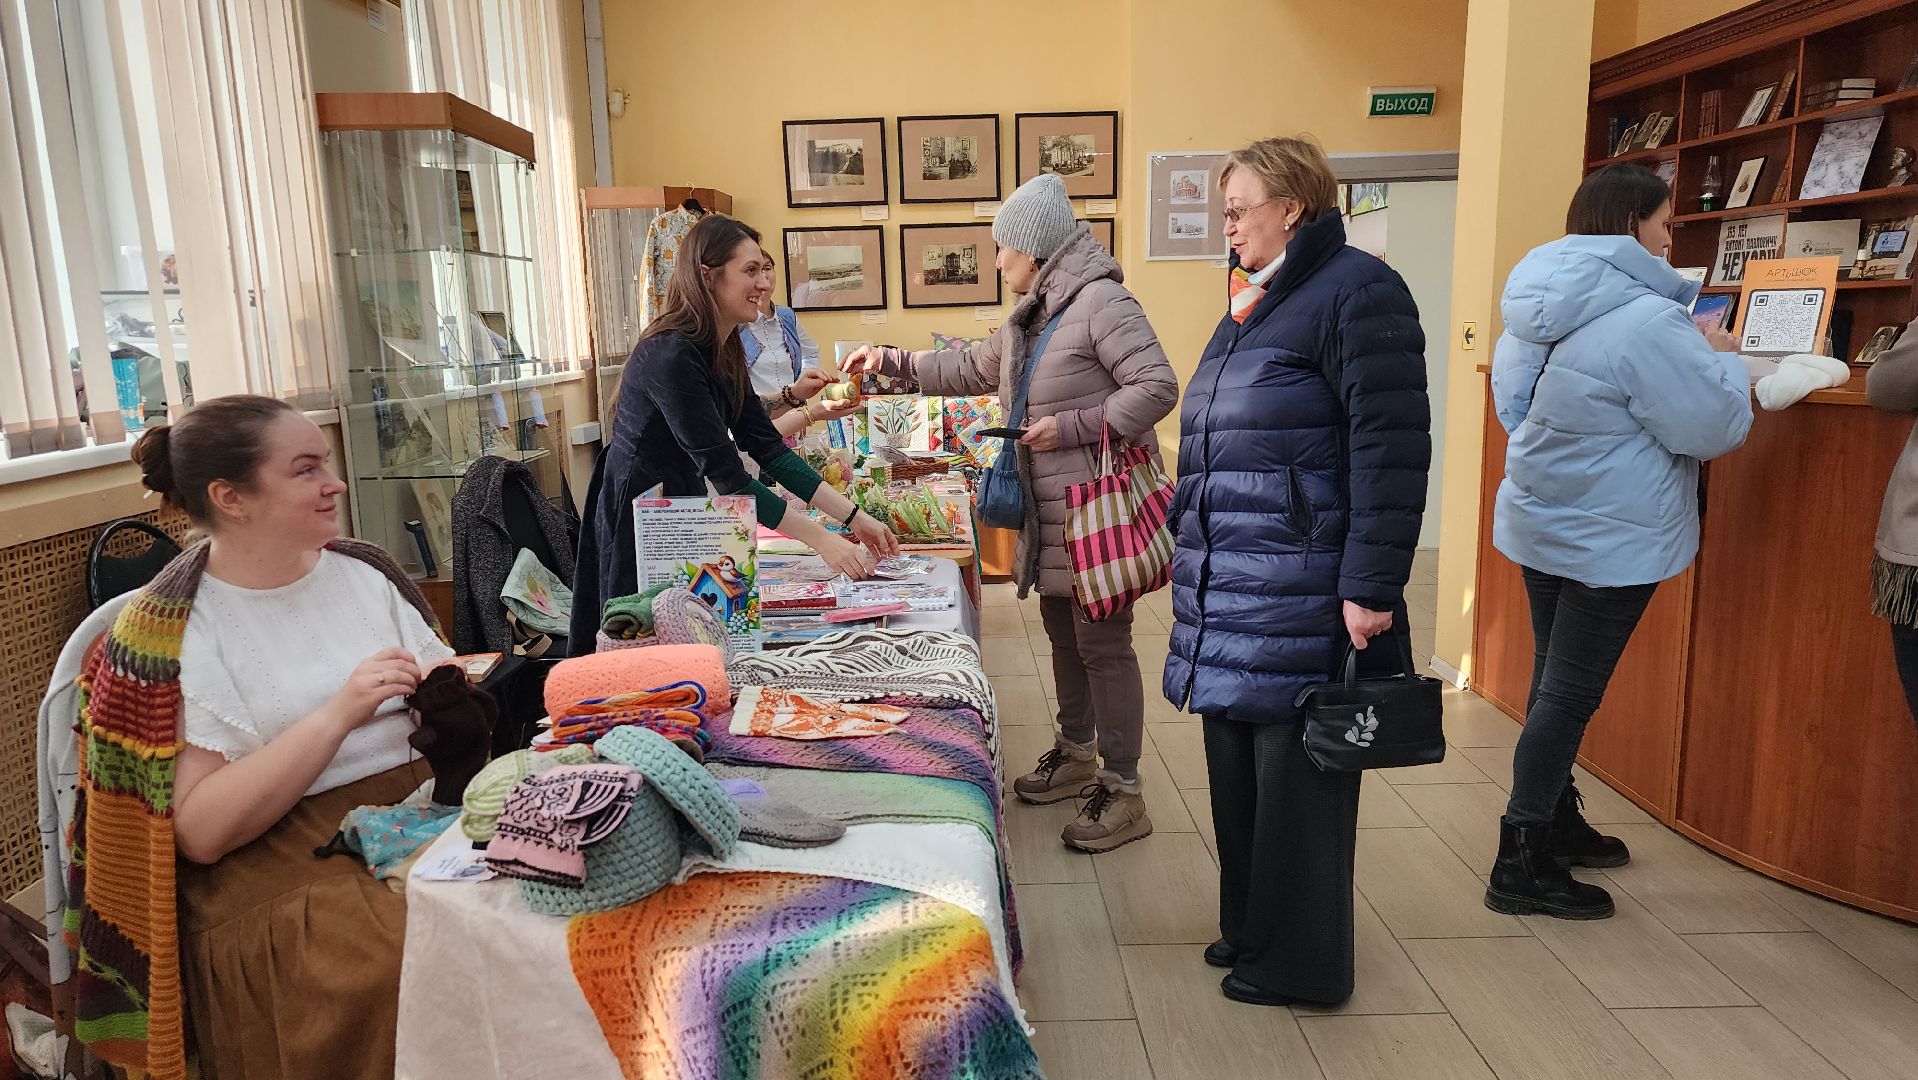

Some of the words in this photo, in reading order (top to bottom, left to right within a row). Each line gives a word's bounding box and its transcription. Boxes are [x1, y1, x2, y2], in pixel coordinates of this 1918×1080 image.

[1375, 97, 1429, 113] ВЫХОД
[1738, 224, 1749, 238] ЛЕТ
[1725, 239, 1745, 252] АНТОНУ
[1746, 235, 1778, 250] ПАВЛОВИЧУ
